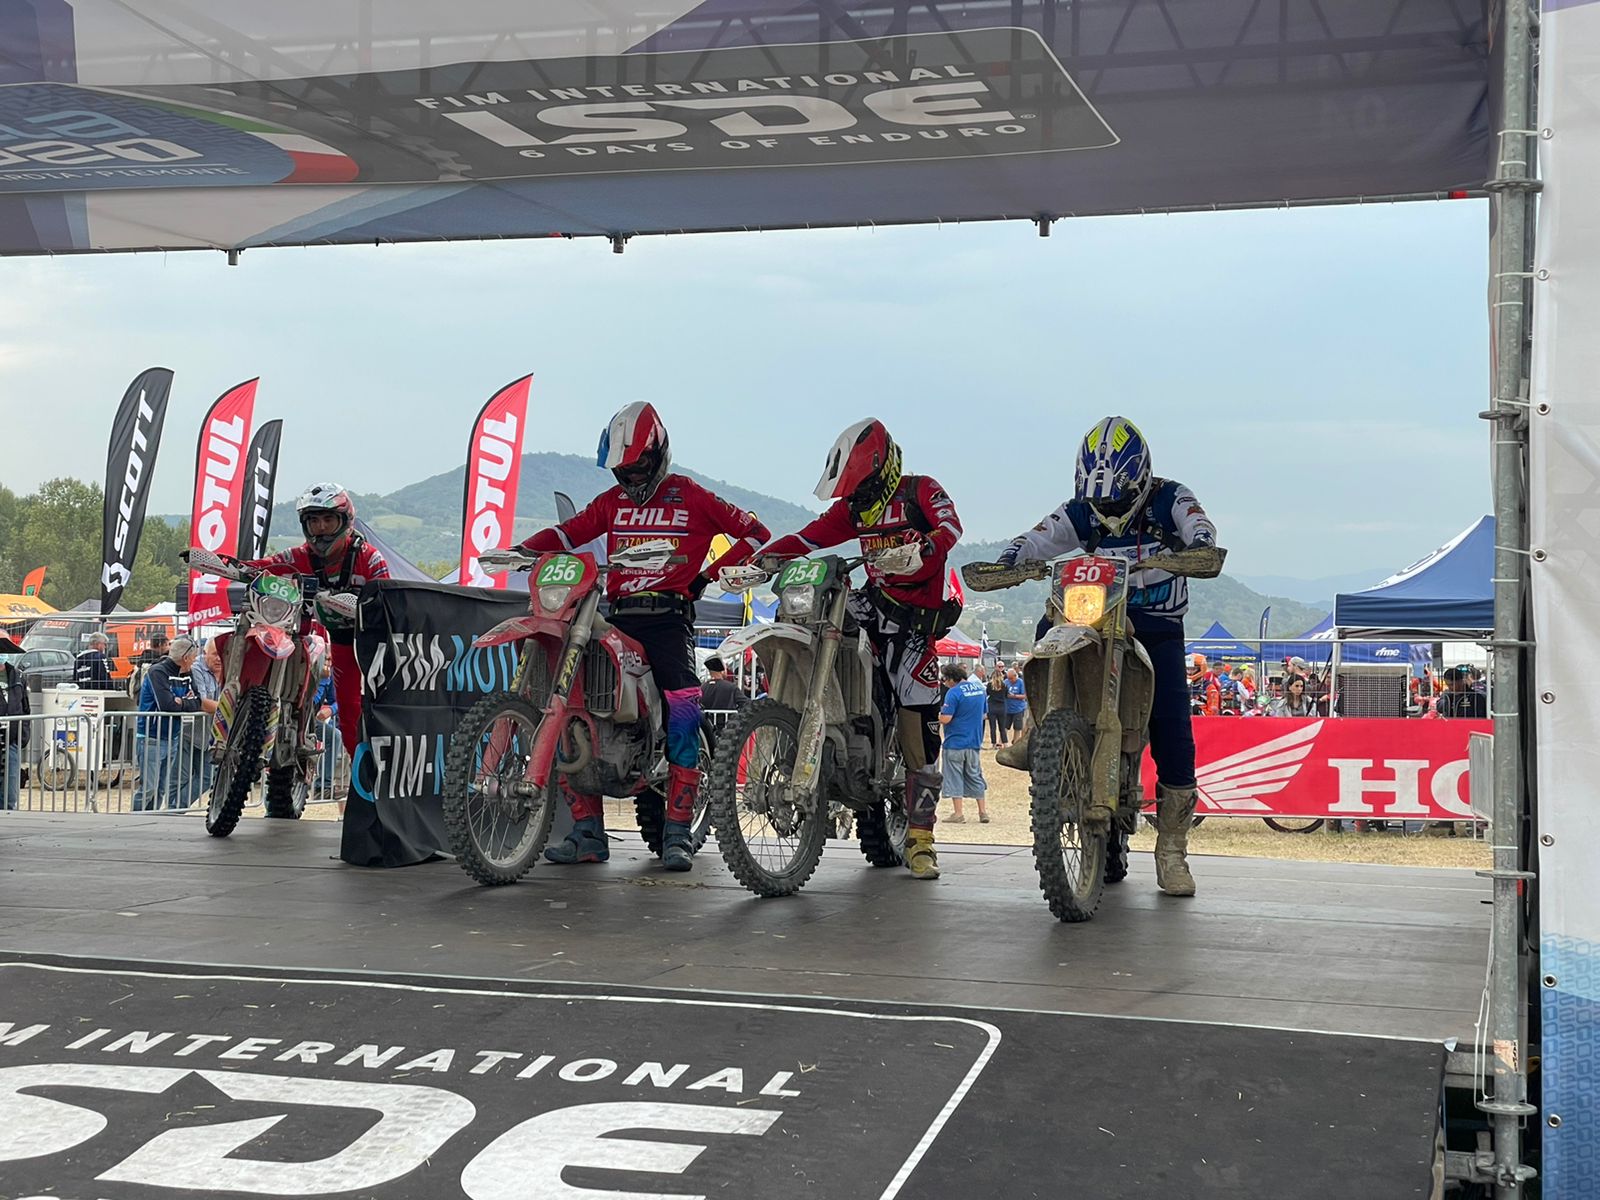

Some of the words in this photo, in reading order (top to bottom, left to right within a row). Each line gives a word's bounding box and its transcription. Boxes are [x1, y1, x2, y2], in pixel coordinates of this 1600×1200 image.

[414, 91, 510, 110] FIM
[526, 65, 976, 101] INTERNATIONAL
[441, 80, 1016, 147] ISDE
[518, 149, 546, 159] 6
[565, 142, 695, 157] DAYS
[720, 138, 779, 150] OF
[807, 124, 1027, 146] ENDURO
[101, 167, 250, 178] PIEMONTE
[113, 389, 154, 560] SCOTT
[613, 507, 689, 527] CHILE
[541, 564, 577, 582] 256
[785, 564, 818, 585] 254
[1073, 565, 1101, 583] 50
[269, 582, 289, 598] 96
[187, 606, 223, 624] MOTUL
[133, 641, 151, 651] RAC
[1375, 647, 1400, 657] rfme
[392, 633, 518, 693] FIM-MOT
[64, 1028, 801, 1098] INTERNATIONAL
